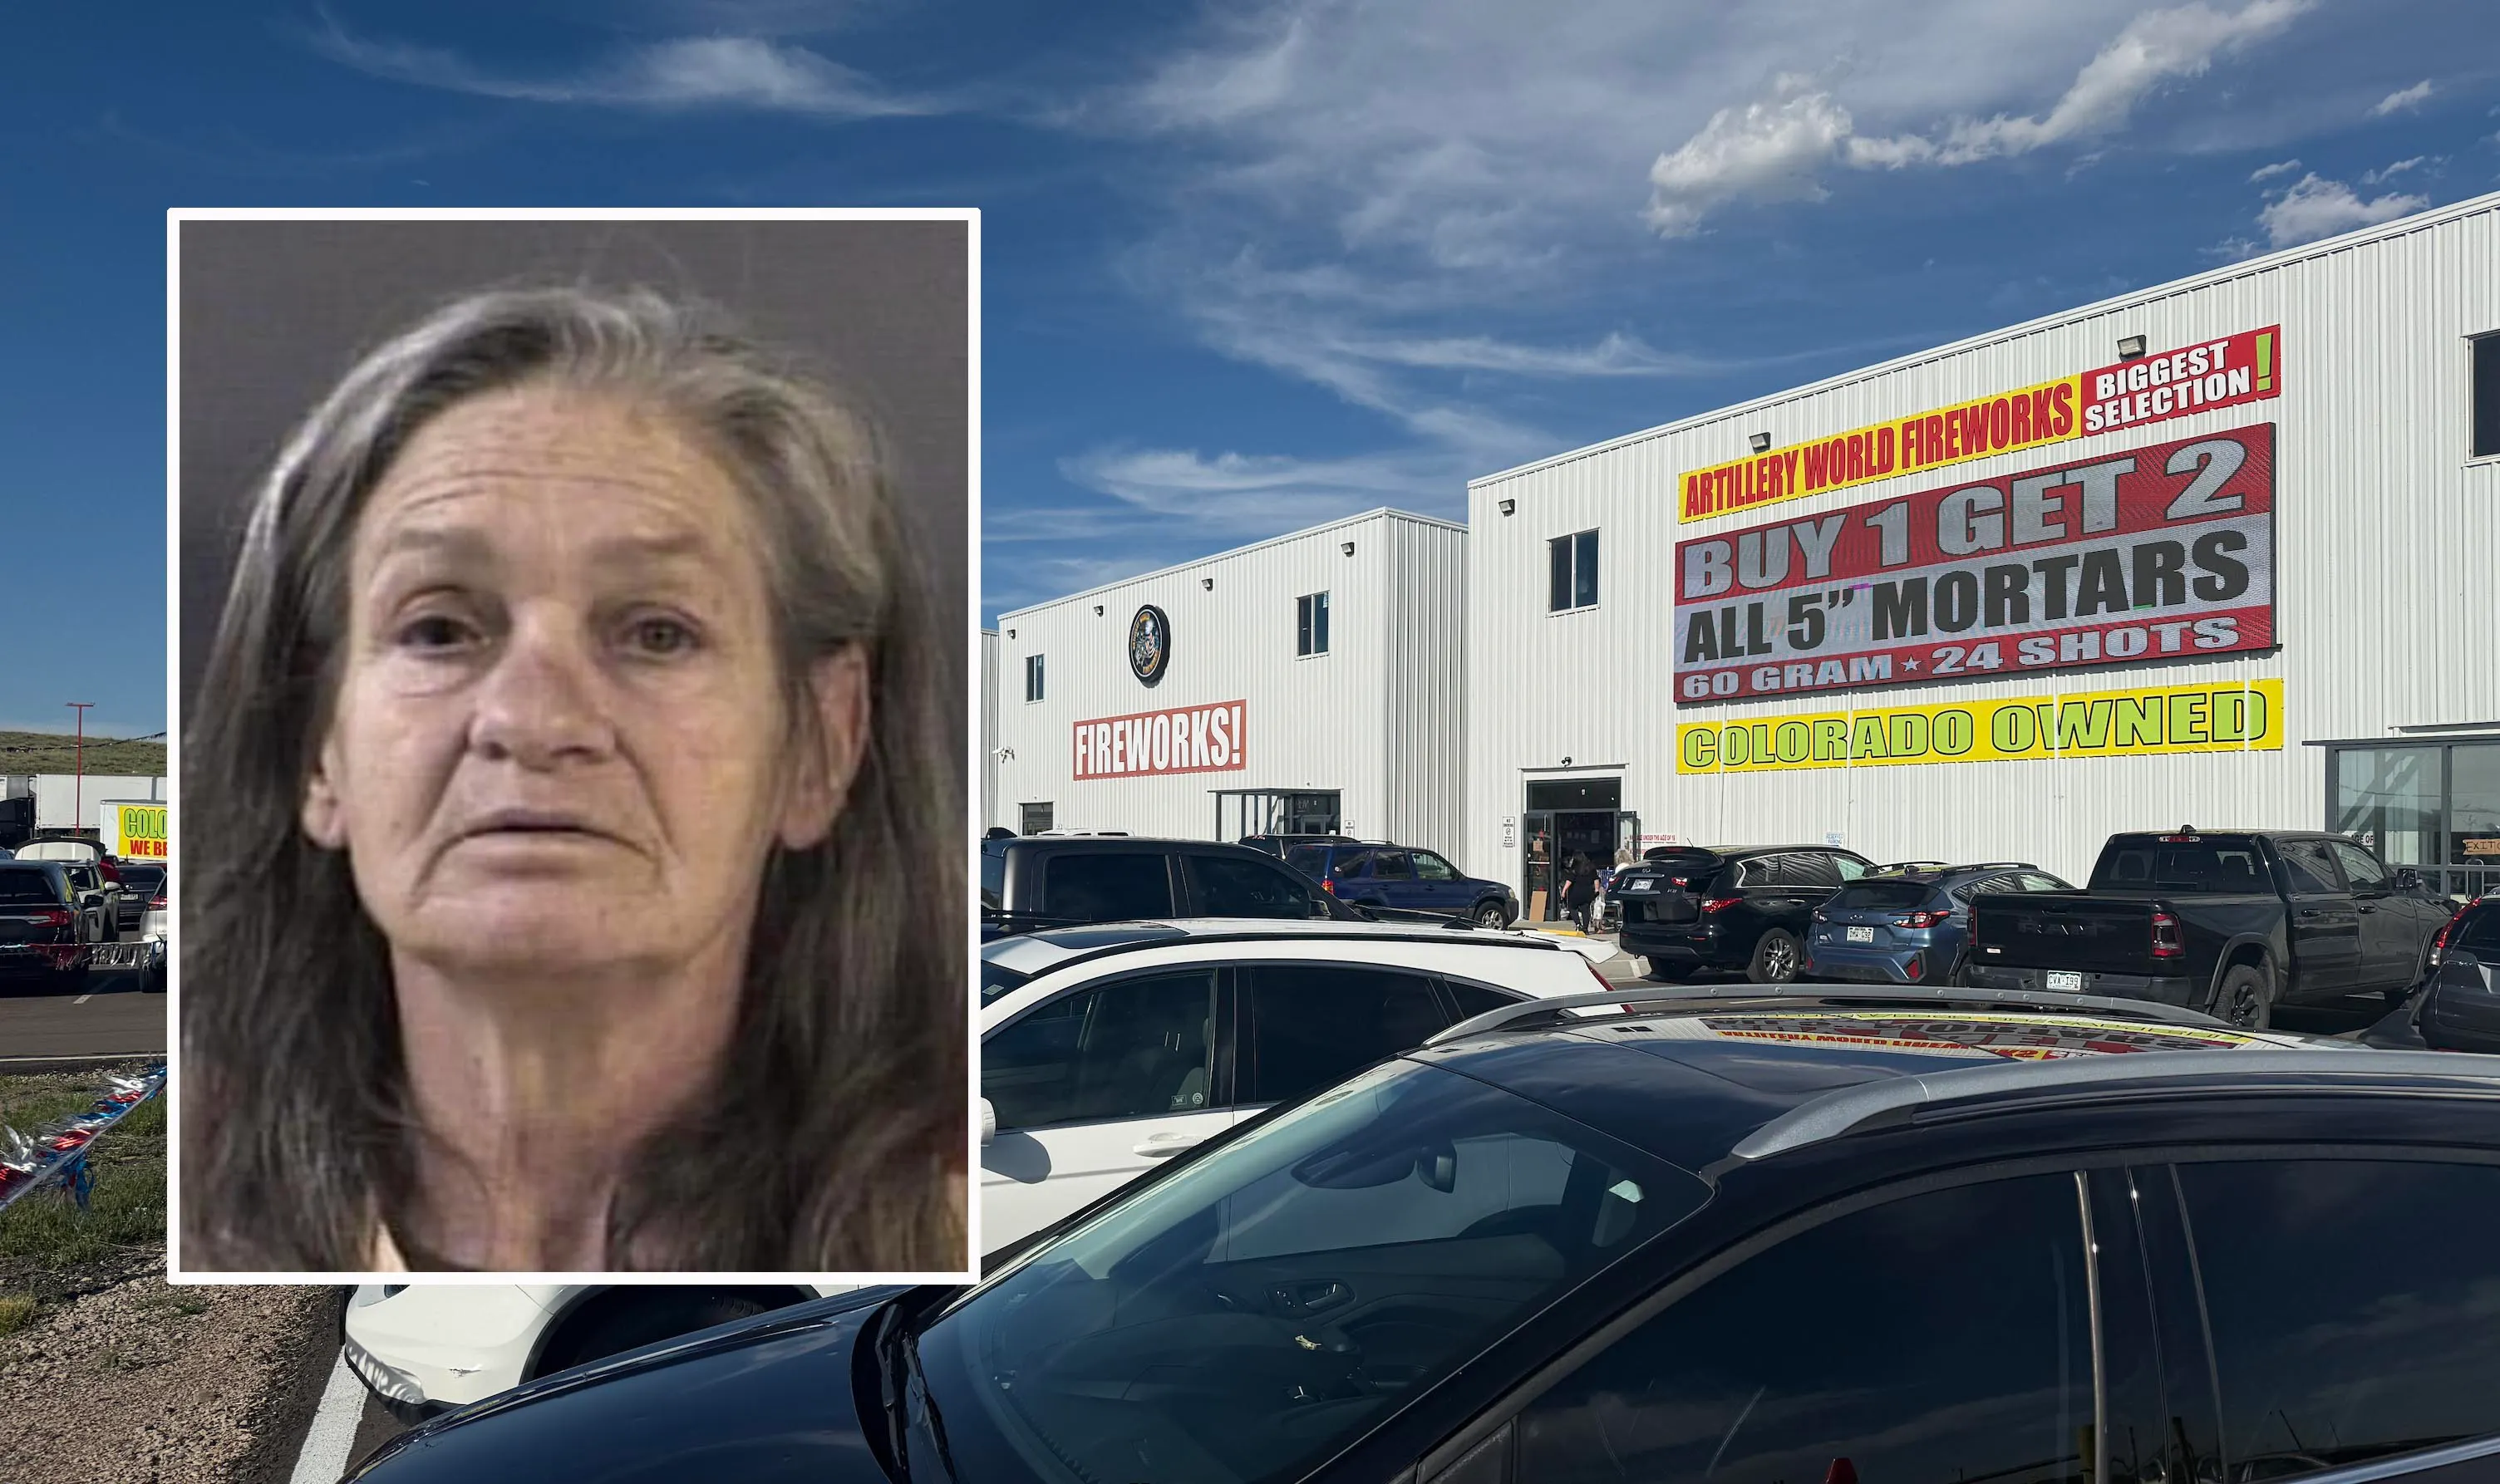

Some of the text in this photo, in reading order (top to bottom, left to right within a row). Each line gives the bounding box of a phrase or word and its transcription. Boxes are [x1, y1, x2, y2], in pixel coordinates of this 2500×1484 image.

[2084, 366, 2251, 432] SELECTION
[2095, 341, 2231, 398] BIGGEST
[1686, 382, 2074, 518] ARTILLERY WORLD FIREWORKS
[1682, 438, 2247, 600] BUY 1 GET 2
[1684, 603, 1773, 664] ALL
[1873, 530, 2250, 641] MORTARS
[1682, 617, 2240, 700] 60 GRAM 24 SHOTS
[1075, 705, 1242, 776] FIREWORKS!
[1683, 690, 2267, 769] COLORADO OWNED
[130, 839, 150, 855] WE
[2365, 834, 2374, 843] OF
[2466, 841, 2495, 853] EXIT
